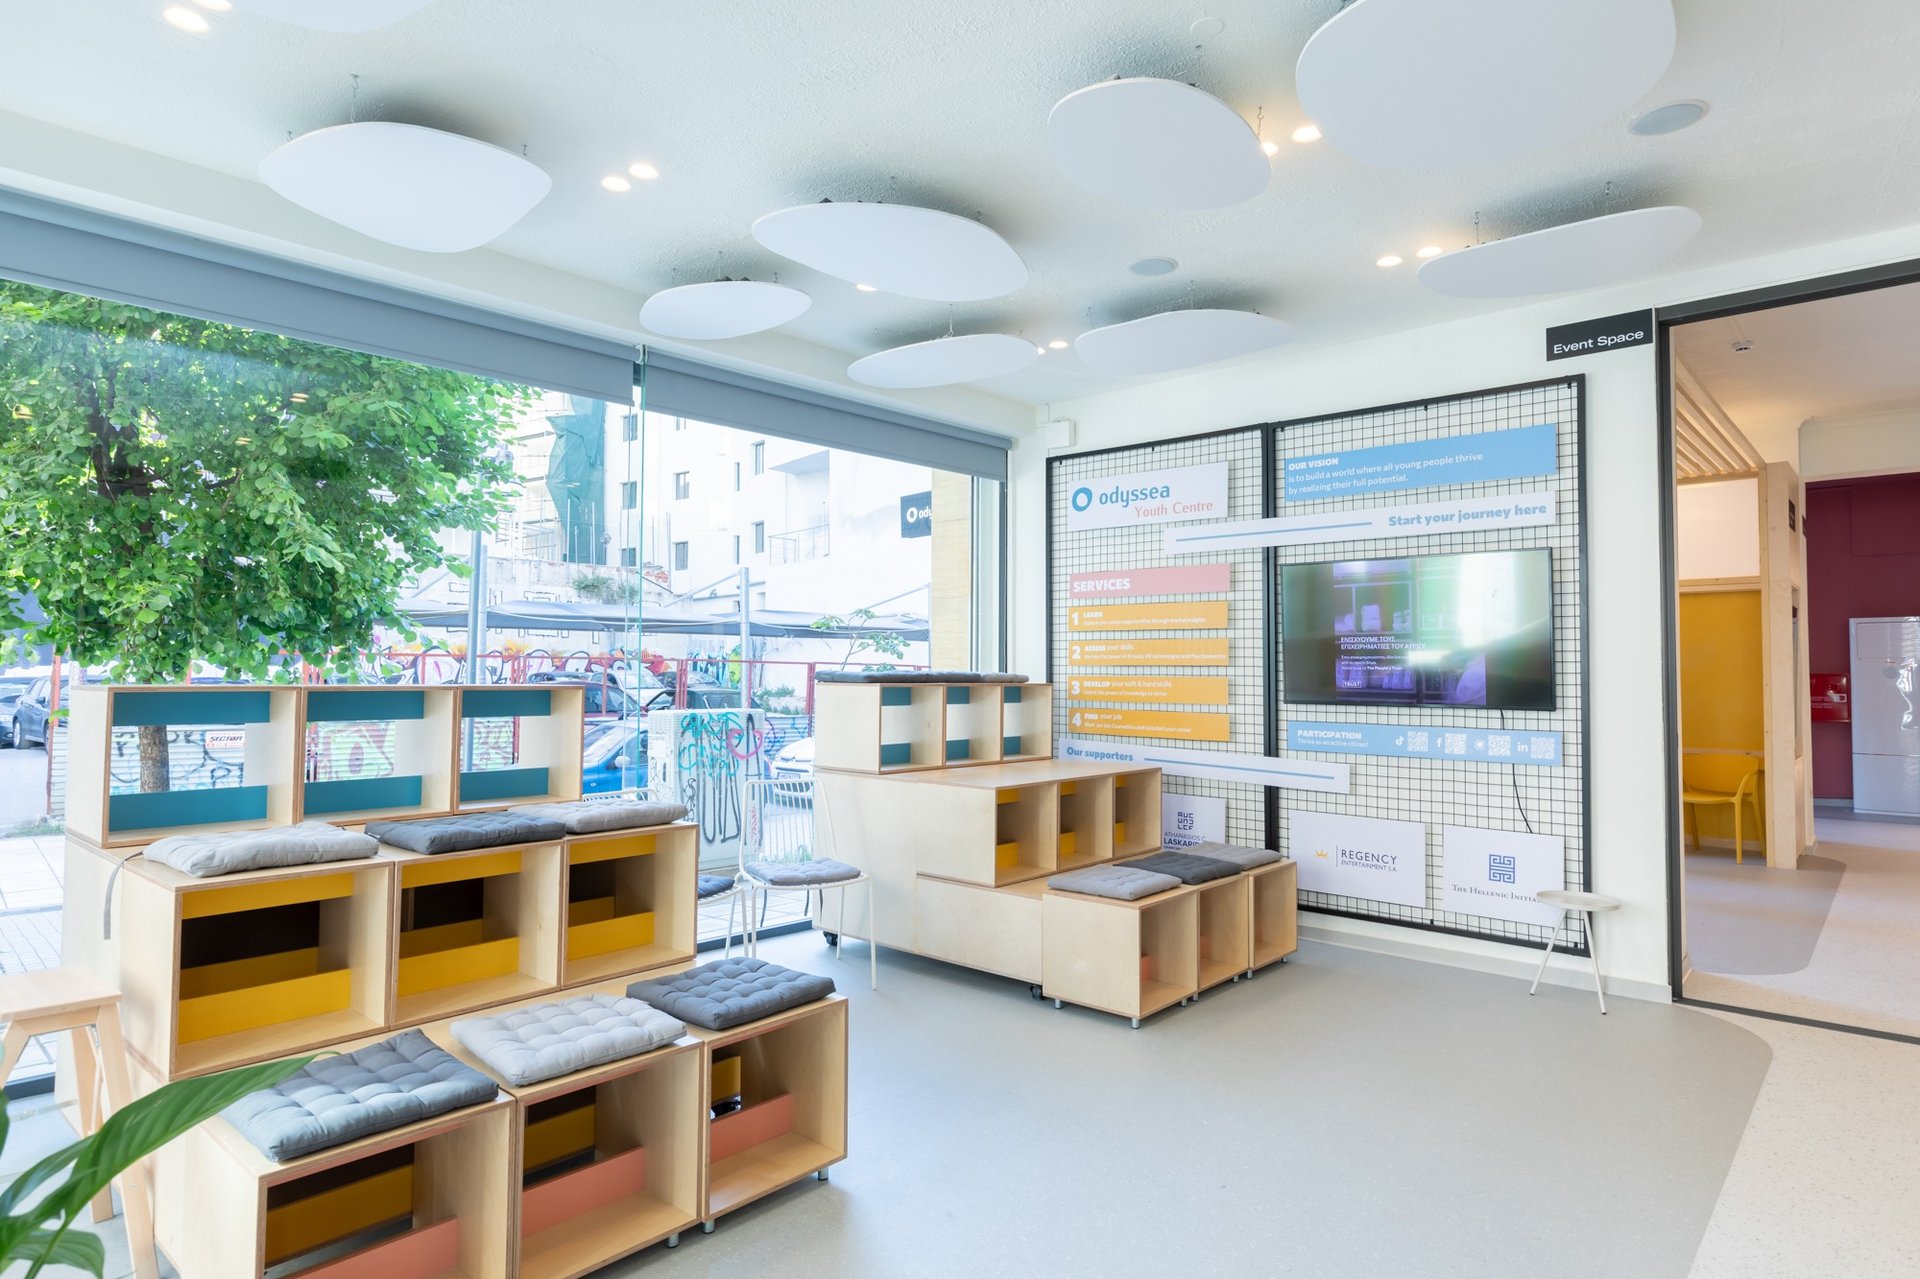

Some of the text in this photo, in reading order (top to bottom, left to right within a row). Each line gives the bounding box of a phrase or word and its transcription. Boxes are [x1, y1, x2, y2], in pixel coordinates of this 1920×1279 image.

[1553, 331, 1644, 354] Event Space
[1288, 457, 1339, 471] OUR VISION
[1289, 475, 1295, 483] is
[1295, 474, 1304, 482] to
[1305, 470, 1325, 481] build
[1332, 467, 1355, 478] world
[1356, 464, 1382, 475] where
[1383, 462, 1393, 472] all
[1394, 460, 1422, 473] young
[1423, 455, 1454, 469] people
[1455, 452, 1483, 463] thrive
[1289, 473, 1409, 495] by realizing their full potential.
[1099, 485, 1170, 508] odyssea
[1134, 501, 1214, 518] Youth Centre
[1388, 504, 1547, 527] Start your journey here
[1073, 578, 1130, 592] SERVICES
[1072, 611, 1079, 626] 1
[1072, 645, 1081, 660] 2
[1072, 680, 1080, 695] 3
[1071, 712, 1082, 727] 4
[1297, 730, 1362, 740] PARTICIPATION
[1066, 746, 1134, 762] Our supporters
[1164, 831, 1201, 841] ATHANASIOS
[1341, 849, 1397, 865] REGENCY
[1341, 860, 1386, 870] ENTERTAINMENT
[1470, 886, 1509, 899] HELLENIC
[1510, 892, 1538, 903] INITIA
